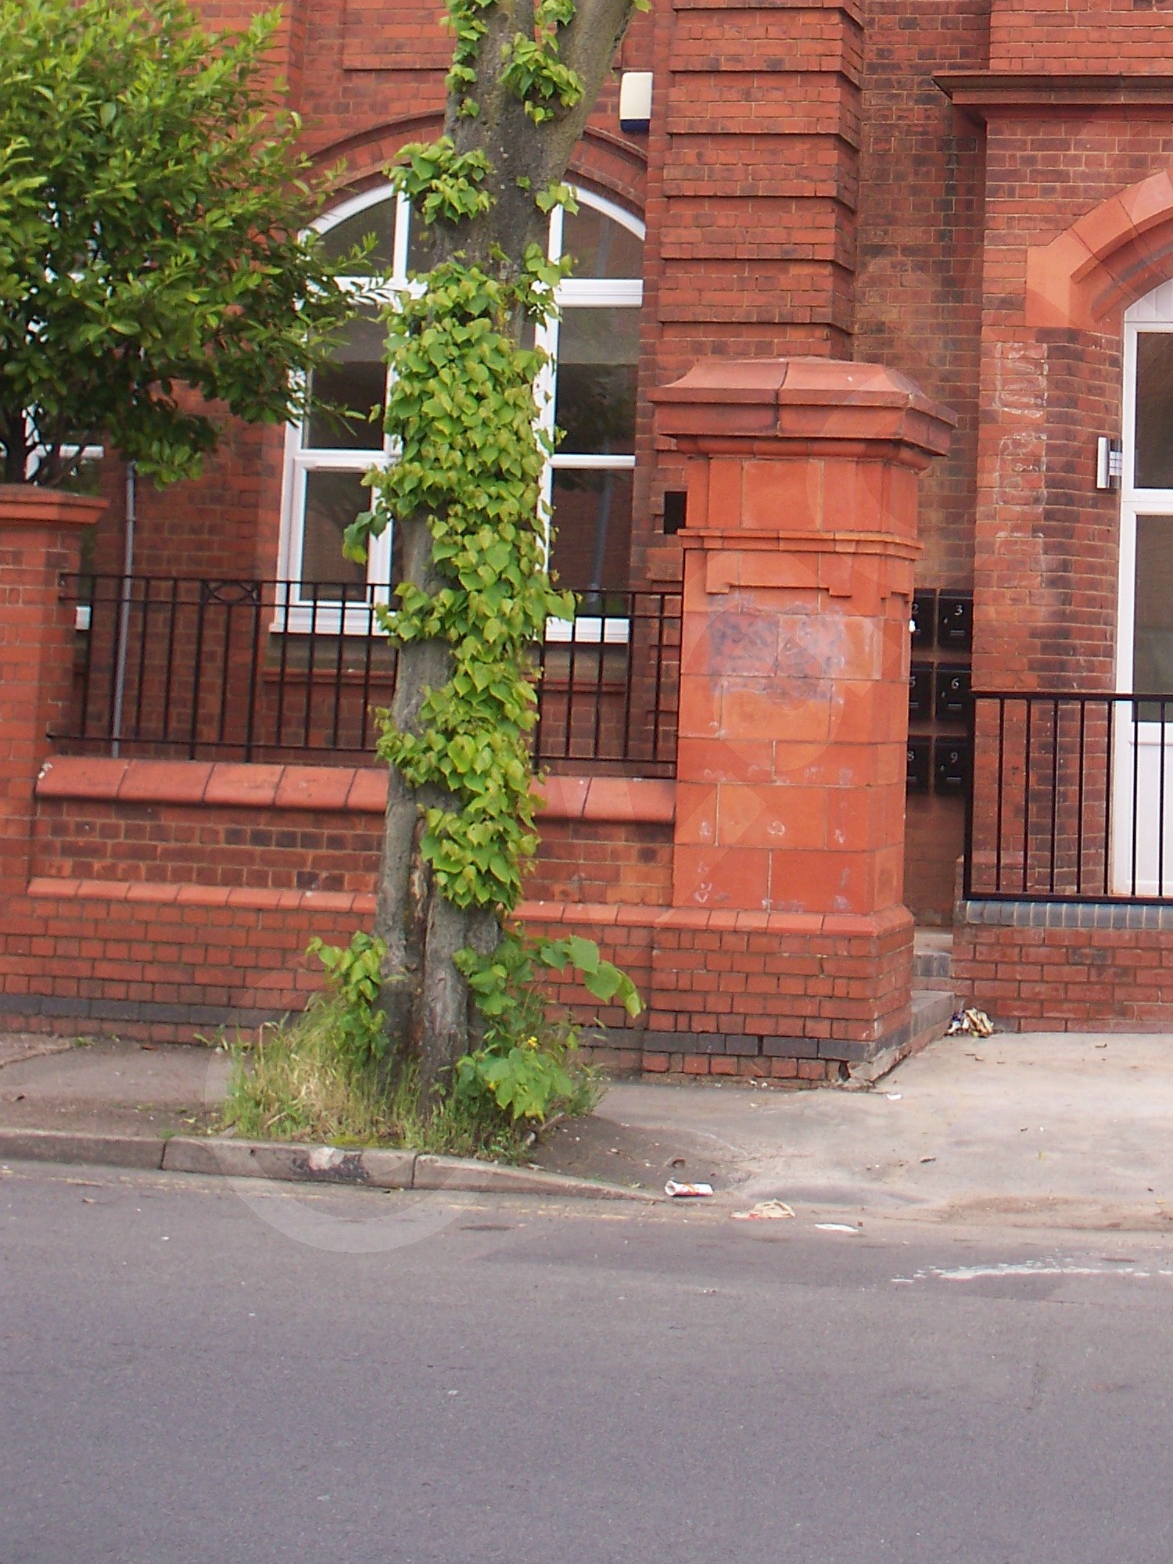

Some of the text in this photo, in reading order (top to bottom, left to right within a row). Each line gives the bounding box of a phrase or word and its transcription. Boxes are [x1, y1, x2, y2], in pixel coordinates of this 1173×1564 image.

[954, 604, 963, 616] 3
[951, 678, 960, 689] 6
[950, 751, 958, 763] 9
